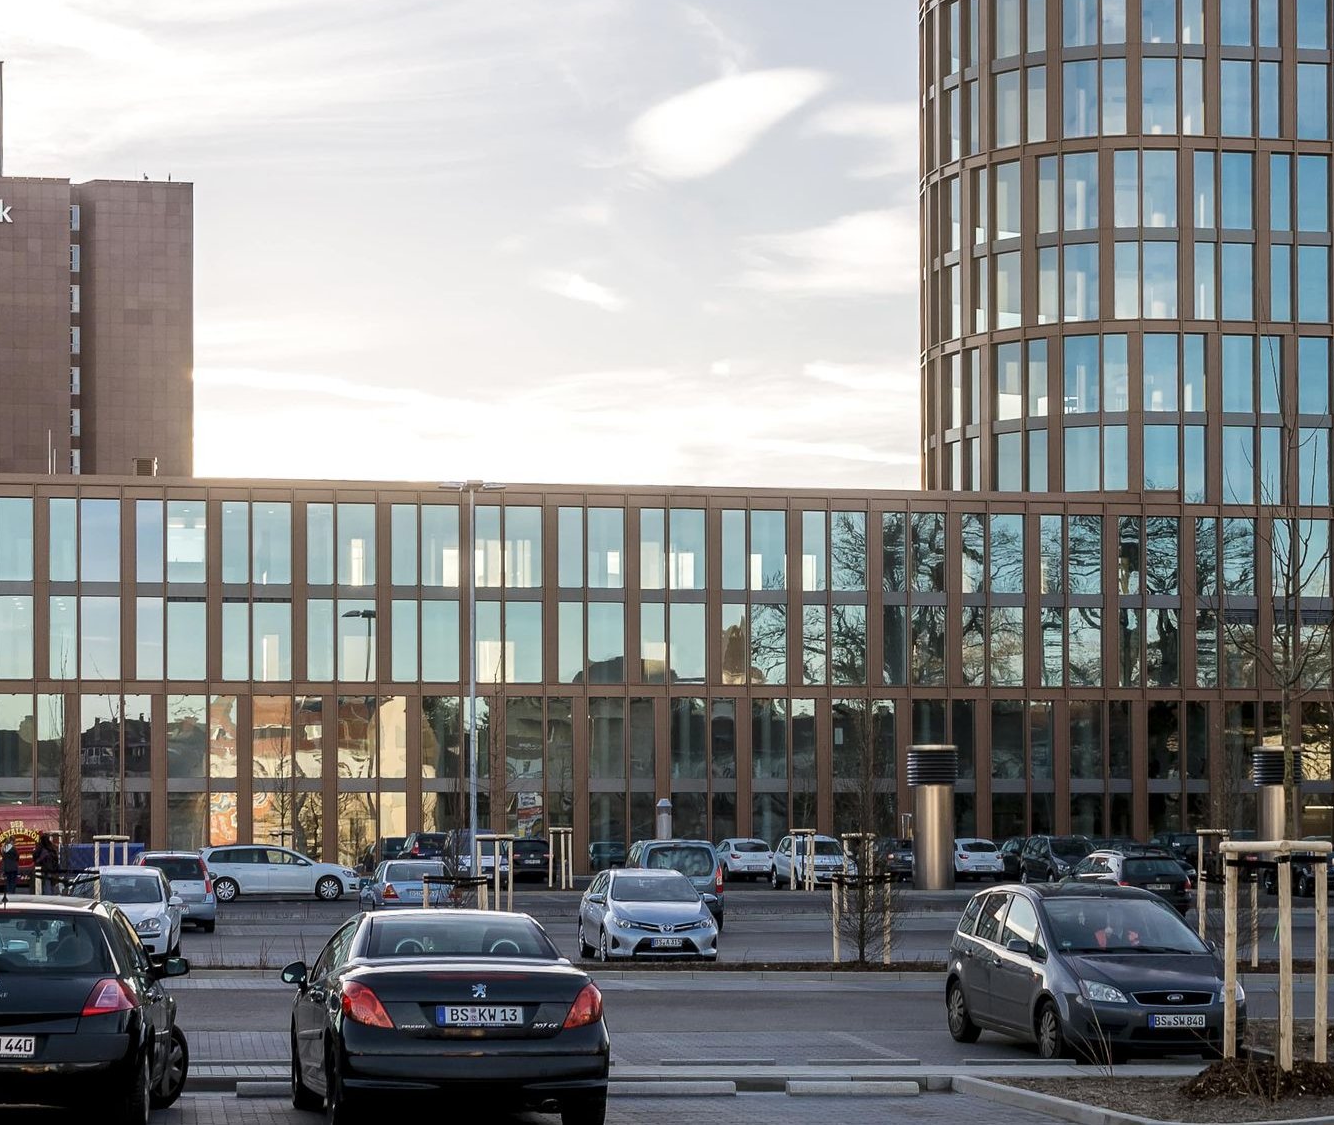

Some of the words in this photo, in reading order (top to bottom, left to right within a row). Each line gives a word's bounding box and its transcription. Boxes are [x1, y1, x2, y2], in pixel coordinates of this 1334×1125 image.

[450, 1008, 469, 1022] BS
[478, 1008, 497, 1022] KW
[501, 1008, 518, 1022] 13
[1154, 1016, 1167, 1026] BS
[1172, 1016, 1185, 1026] SW
[1187, 1016, 1204, 1026] 848
[4, 1038, 33, 1052] 440
